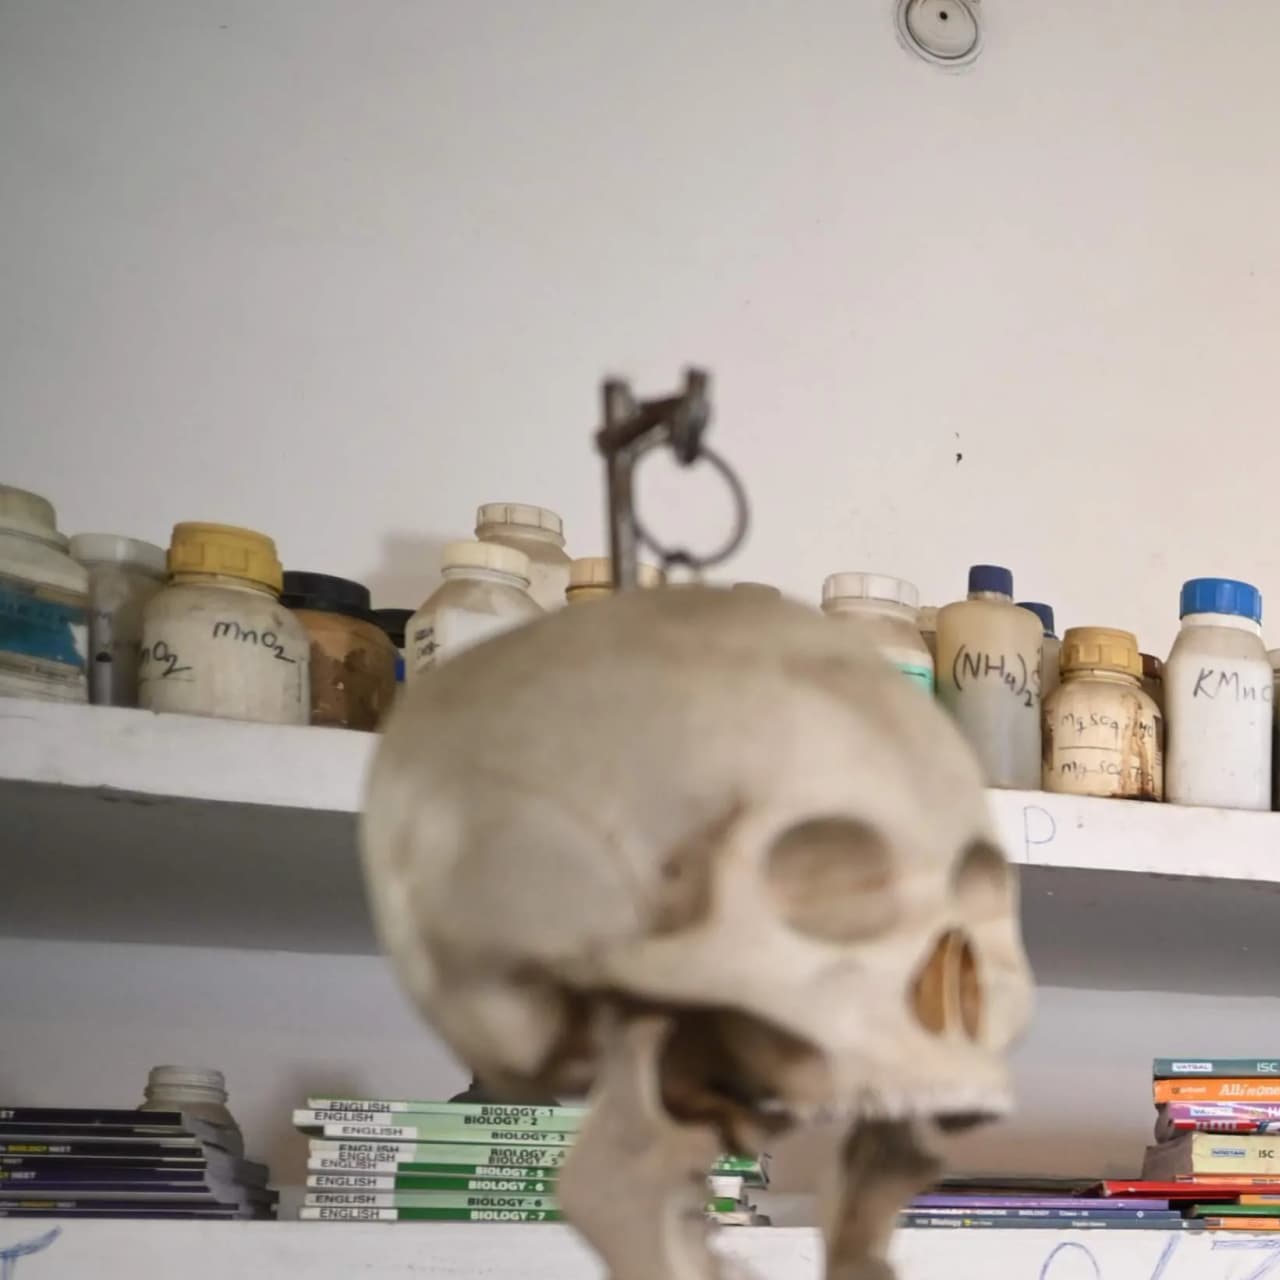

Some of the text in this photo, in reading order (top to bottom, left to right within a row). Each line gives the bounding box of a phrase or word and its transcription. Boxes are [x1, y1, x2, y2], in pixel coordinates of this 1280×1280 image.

[1024, 806, 1057, 864] P
[1257, 1062, 1277, 1072] ISC
[481, 1107, 538, 1117] BIOLOGY
[314, 1112, 374, 1122] ENGLISH
[464, 1116, 521, 1126] BIOLOGY
[342, 1126, 403, 1136] ENGLISH
[491, 1131, 549, 1141] BIOLOGY
[490, 1148, 548, 1157] BIOLOGY
[1259, 1149, 1275, 1160] ISC
[488, 1156, 545, 1165] BIOLOGY
[476, 1166, 530, 1177] BIOLOGY
[316, 1177, 377, 1187] ENGLISH
[468, 1180, 526, 1191] BIOLOGY
[315, 1194, 376, 1204] ENGLISH
[467, 1197, 525, 1207] BIOLOGY
[319, 1209, 380, 1219] ENGLISH
[470, 1210, 528, 1220] BIOLOGY
